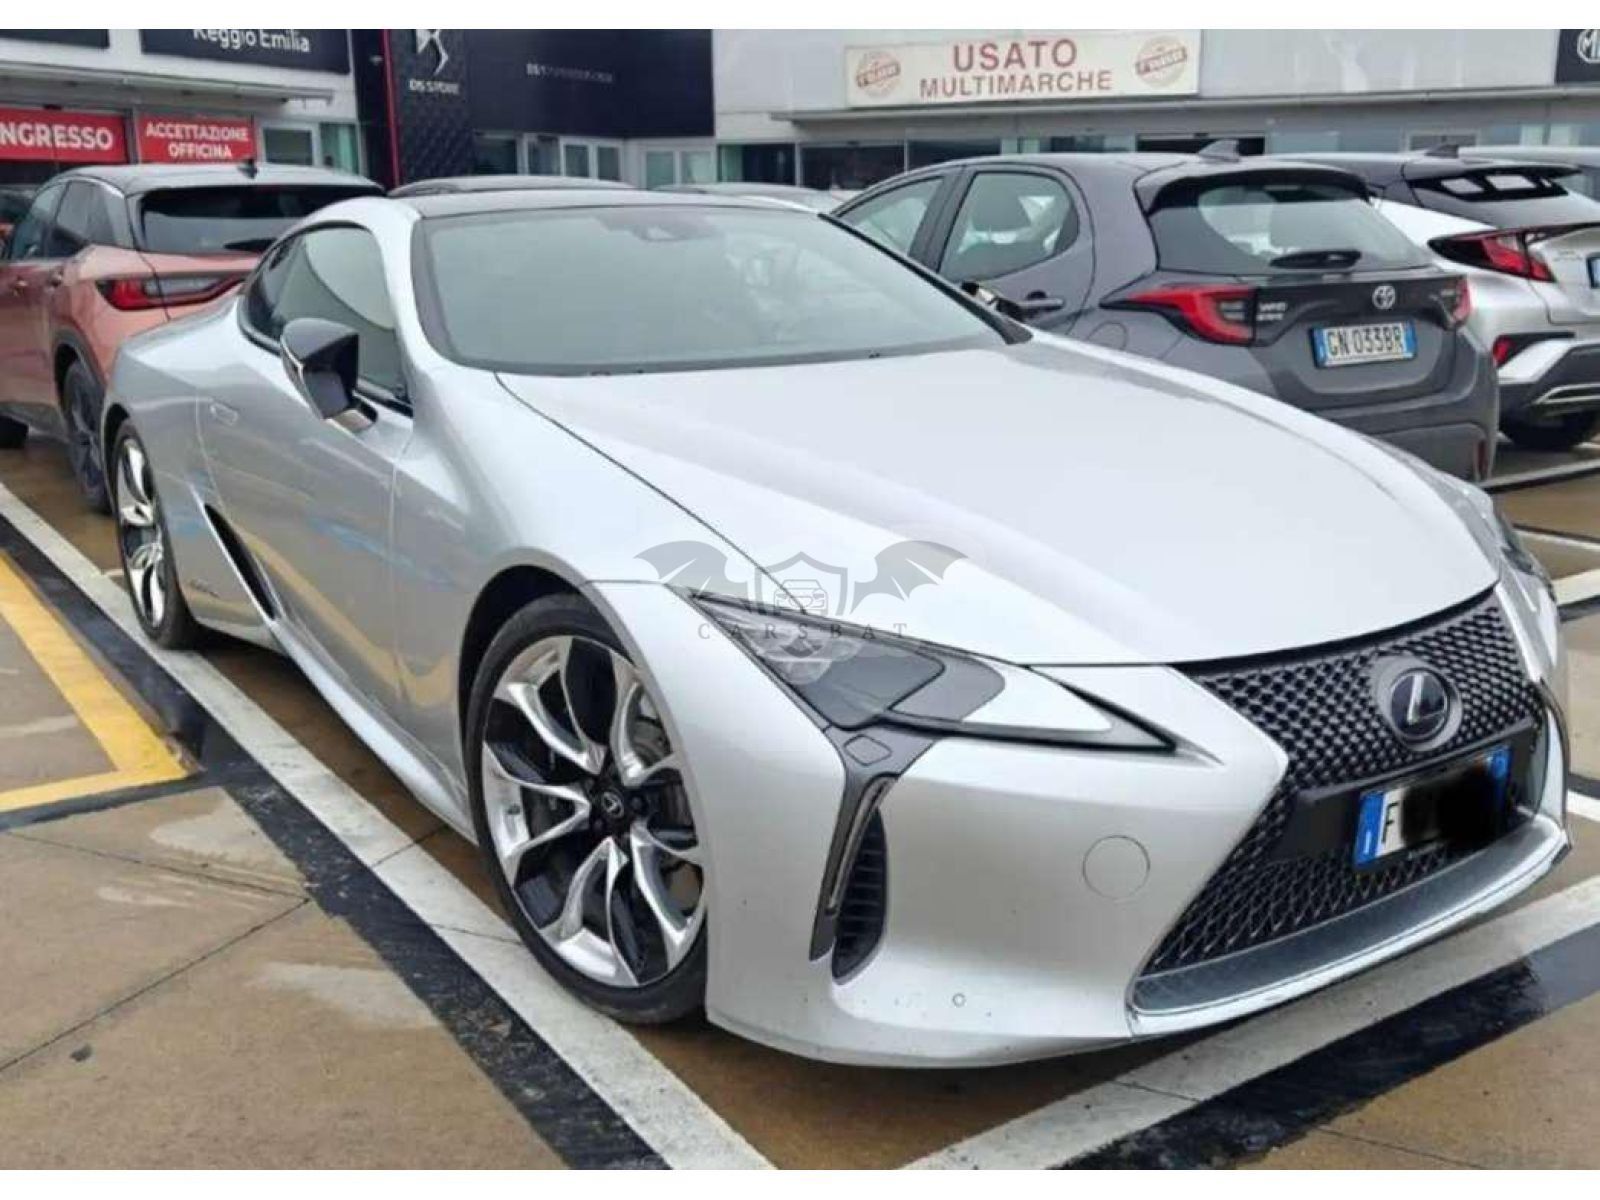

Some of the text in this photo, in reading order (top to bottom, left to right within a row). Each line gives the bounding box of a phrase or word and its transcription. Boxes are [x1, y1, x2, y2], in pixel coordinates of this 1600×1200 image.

[260, 29, 310, 53] Emilia
[953, 38, 1078, 72] USATO
[919, 70, 1113, 99] MULTIMARCHE
[146, 121, 249, 142] ACCETTAZIONE
[168, 143, 232, 158] OFFICINA
